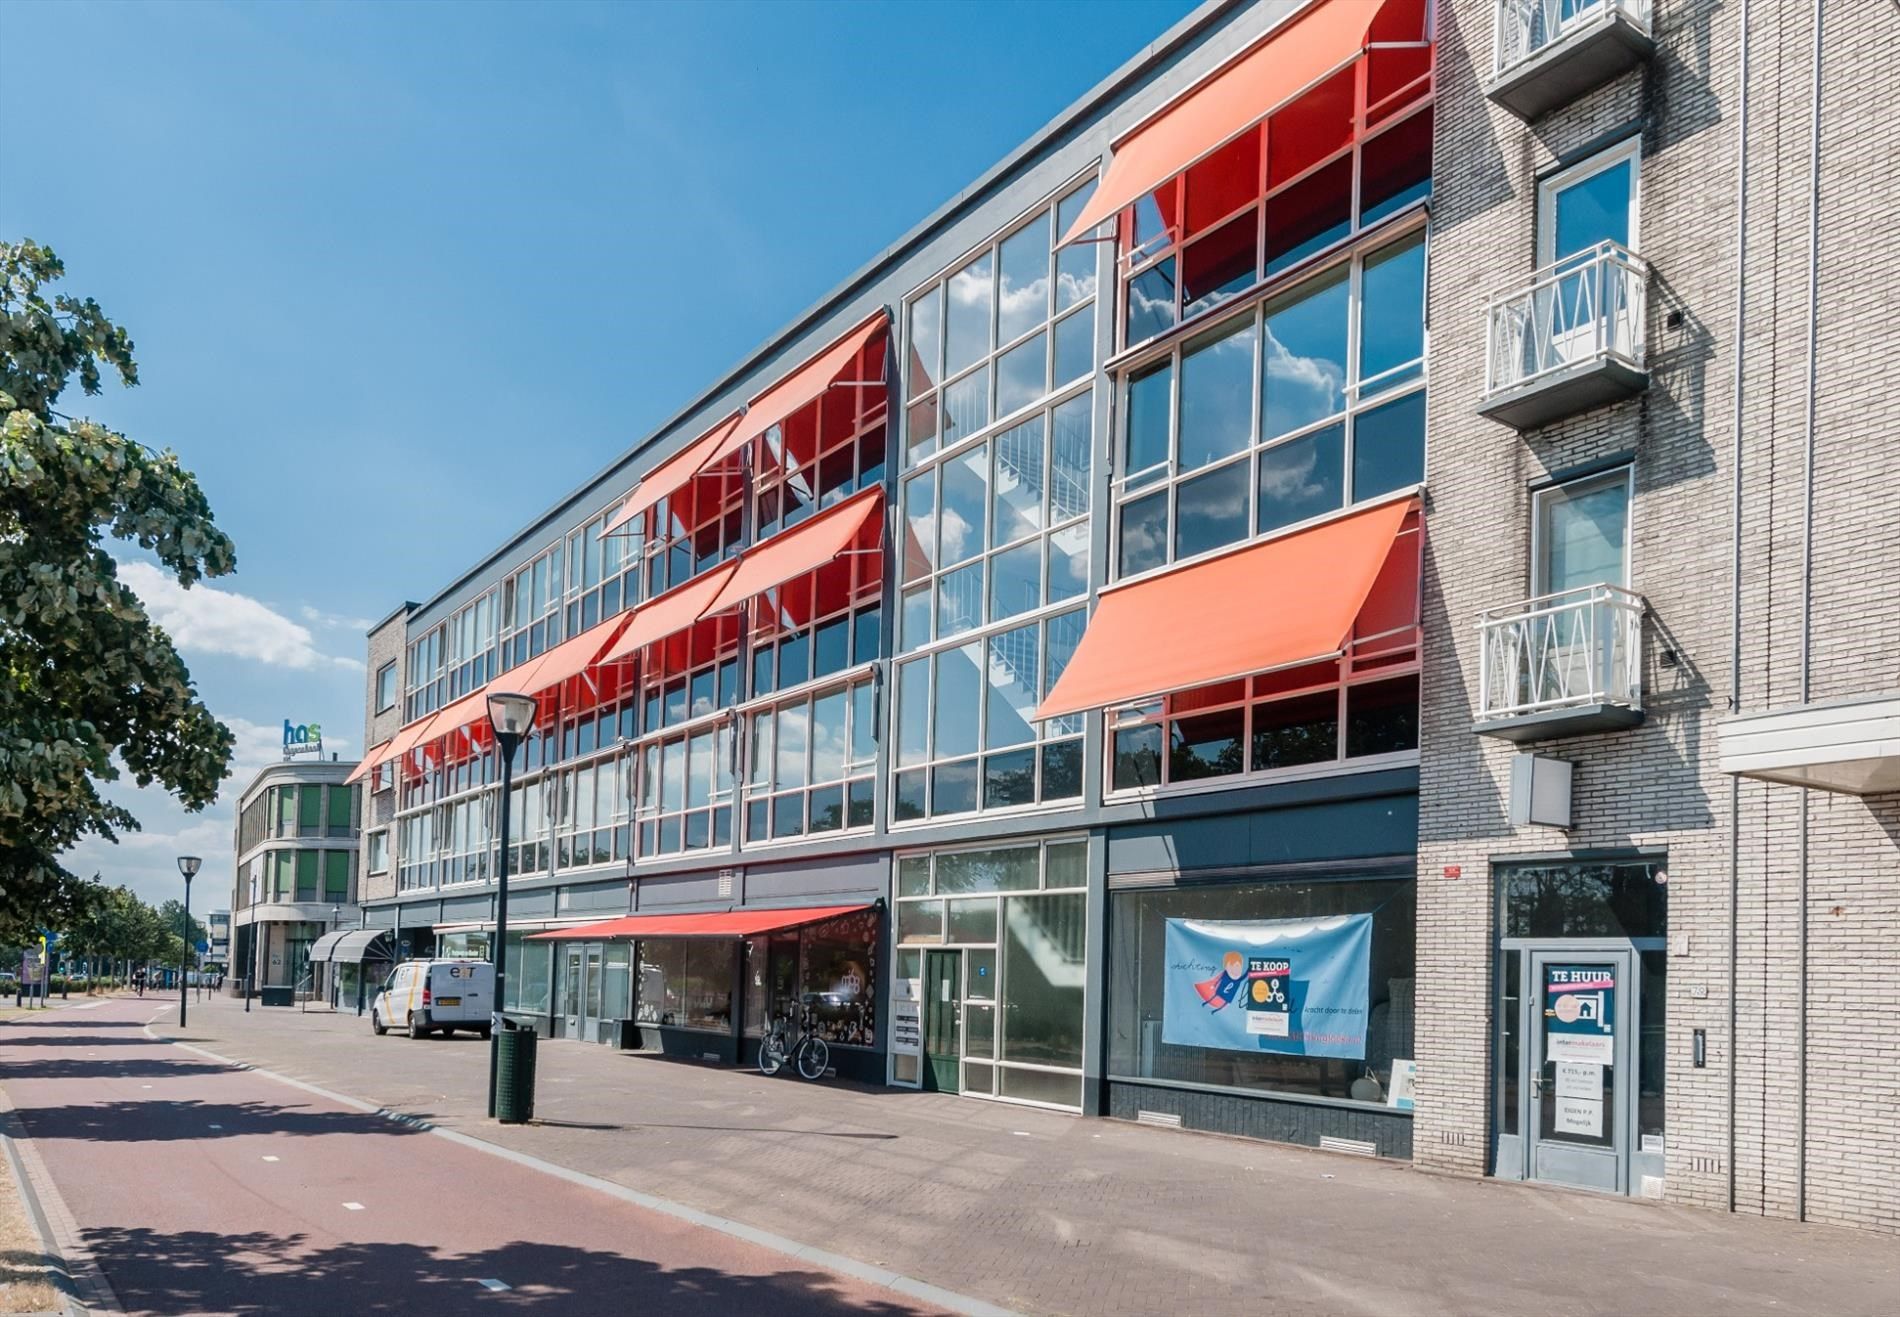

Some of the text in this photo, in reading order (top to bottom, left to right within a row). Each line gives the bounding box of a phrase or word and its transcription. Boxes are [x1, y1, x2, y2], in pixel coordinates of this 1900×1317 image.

[284, 719, 320, 744] has
[1251, 961, 1288, 971] TE KOOP
[1552, 970, 1611, 983] TE HUUR
